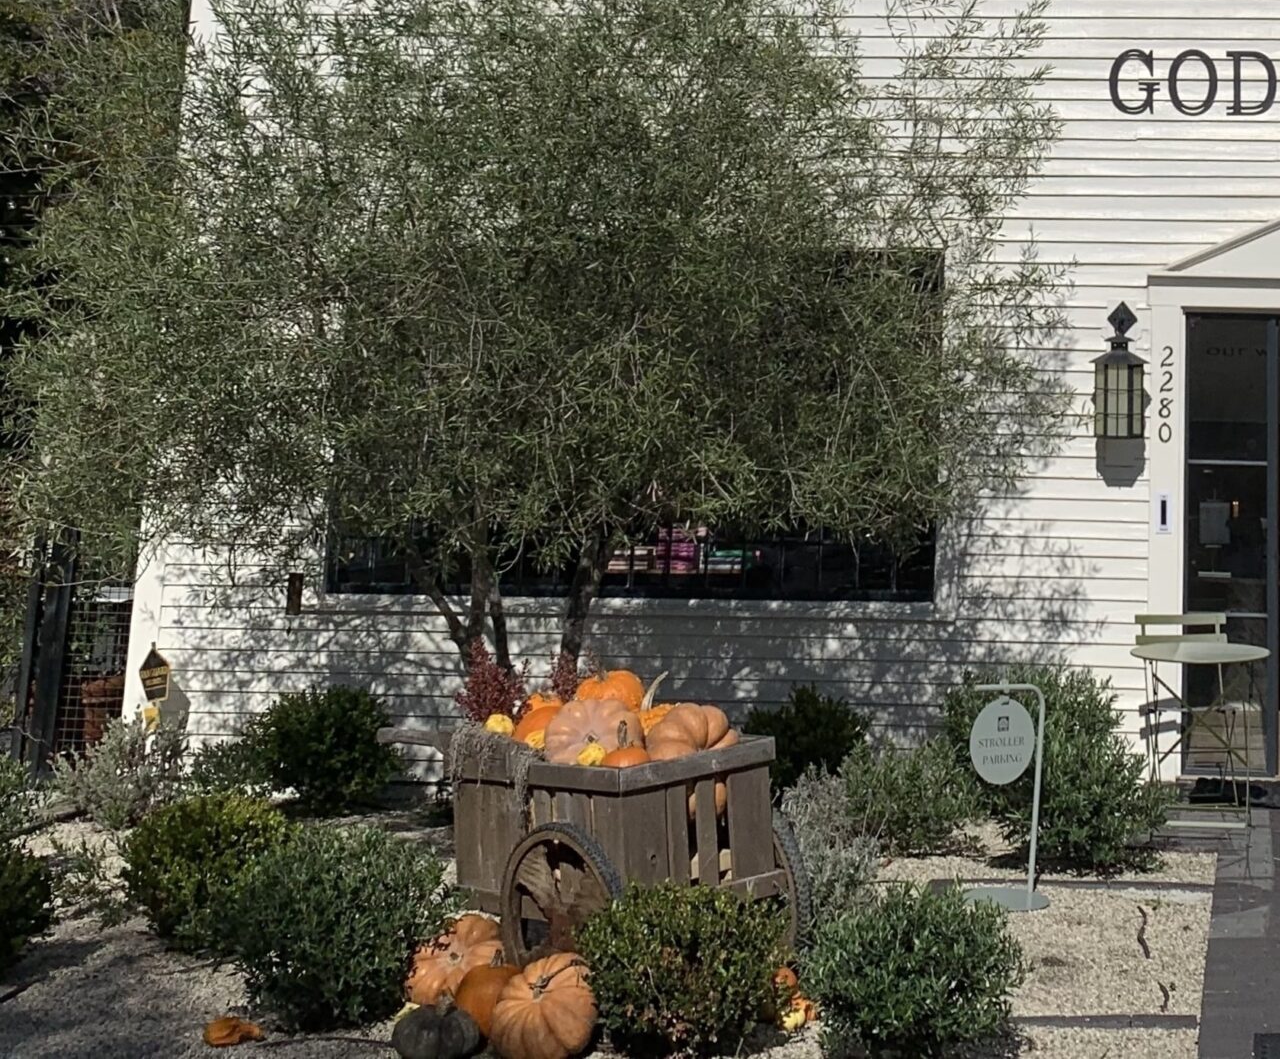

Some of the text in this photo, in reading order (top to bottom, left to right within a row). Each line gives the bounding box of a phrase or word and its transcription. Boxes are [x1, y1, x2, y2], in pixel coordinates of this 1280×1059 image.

[1158, 346, 1174, 443] 2280
[978, 736, 1025, 749] STROLLER
[982, 754, 1023, 765] PARKING
